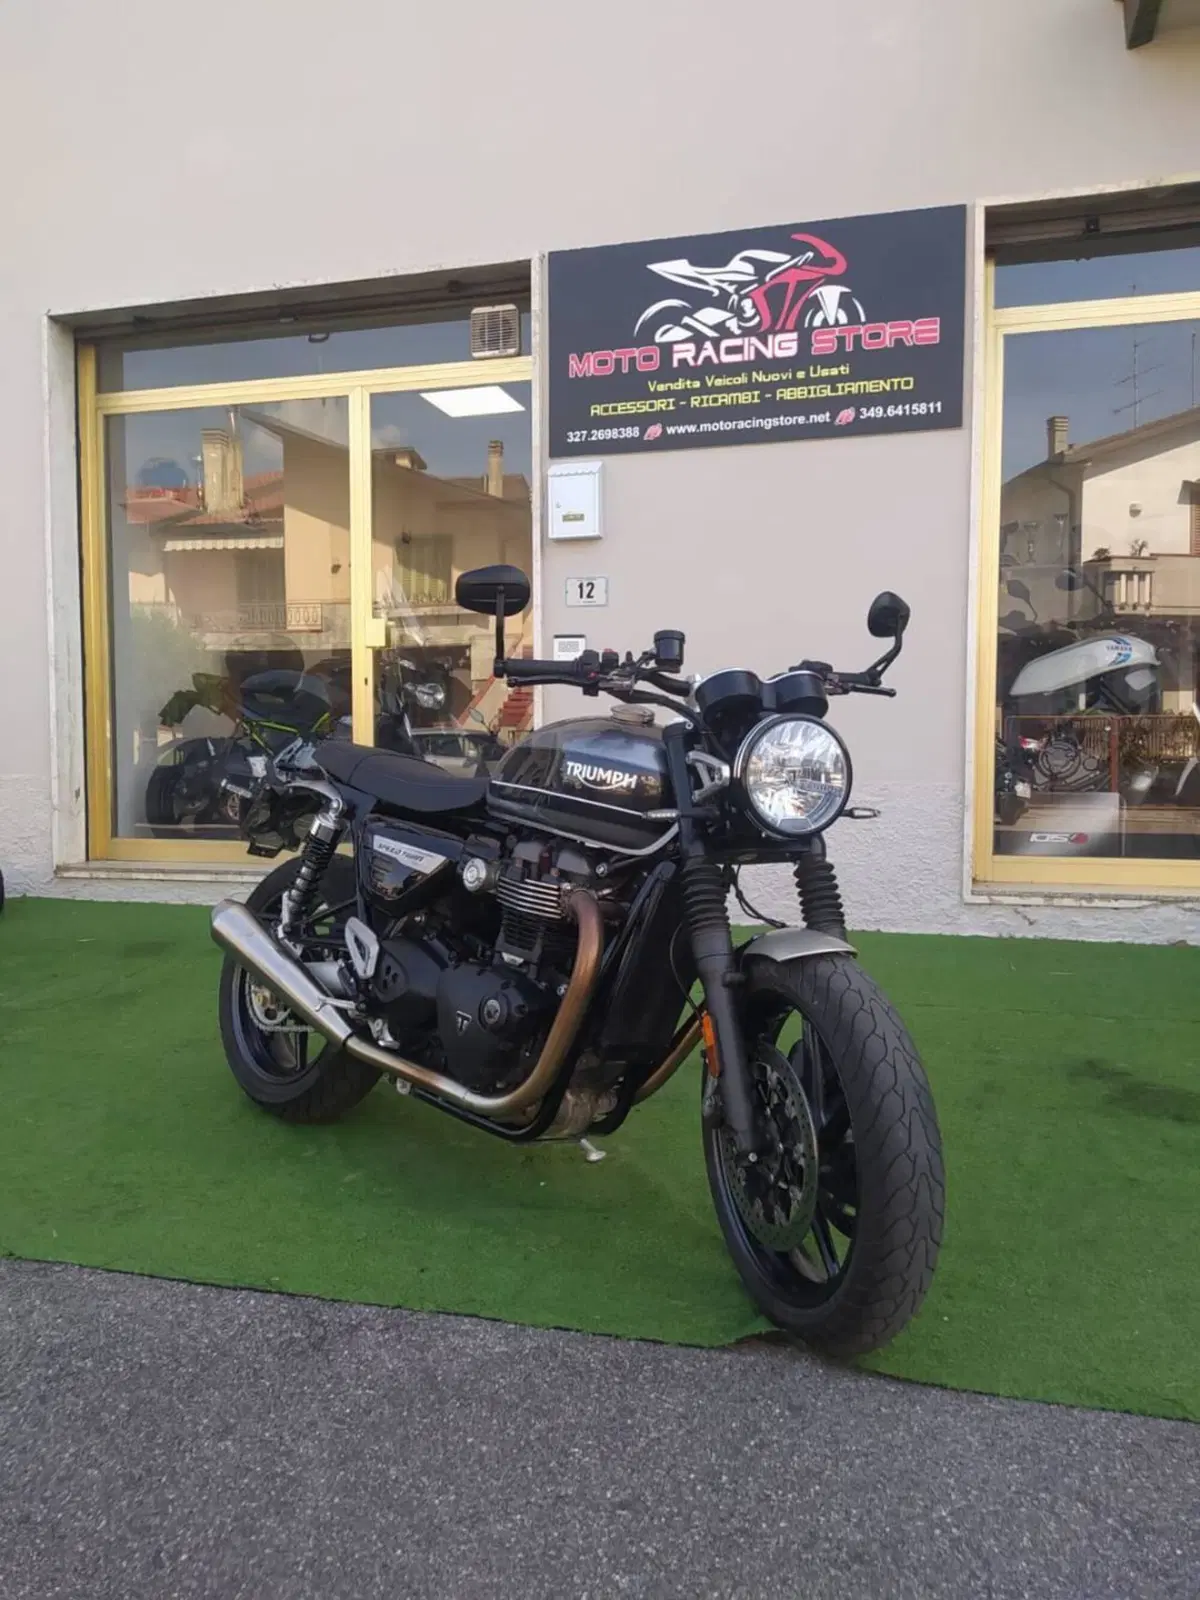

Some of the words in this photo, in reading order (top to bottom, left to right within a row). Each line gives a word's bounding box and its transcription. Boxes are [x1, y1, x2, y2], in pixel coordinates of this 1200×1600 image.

[568, 345, 661, 379] MOTO
[671, 331, 799, 369] RACING
[811, 316, 941, 356] STORE
[647, 378, 701, 393] Vendita
[705, 372, 749, 388] Veicoli
[751, 368, 793, 384] Nuovi
[796, 370, 806, 380] e
[809, 363, 850, 379] Usati
[590, 397, 676, 418] ACCESSORI
[690, 390, 761, 410] RICAMBI
[776, 376, 915, 402] ABBIGLIAMENTO
[566, 426, 640, 444] 327.2698388
[666, 411, 831, 436] www.motoracingstore.net
[859, 400, 942, 420] 349.6415811
[577, 581, 595, 599] 12
[566, 760, 638, 790] TRIUMPH
